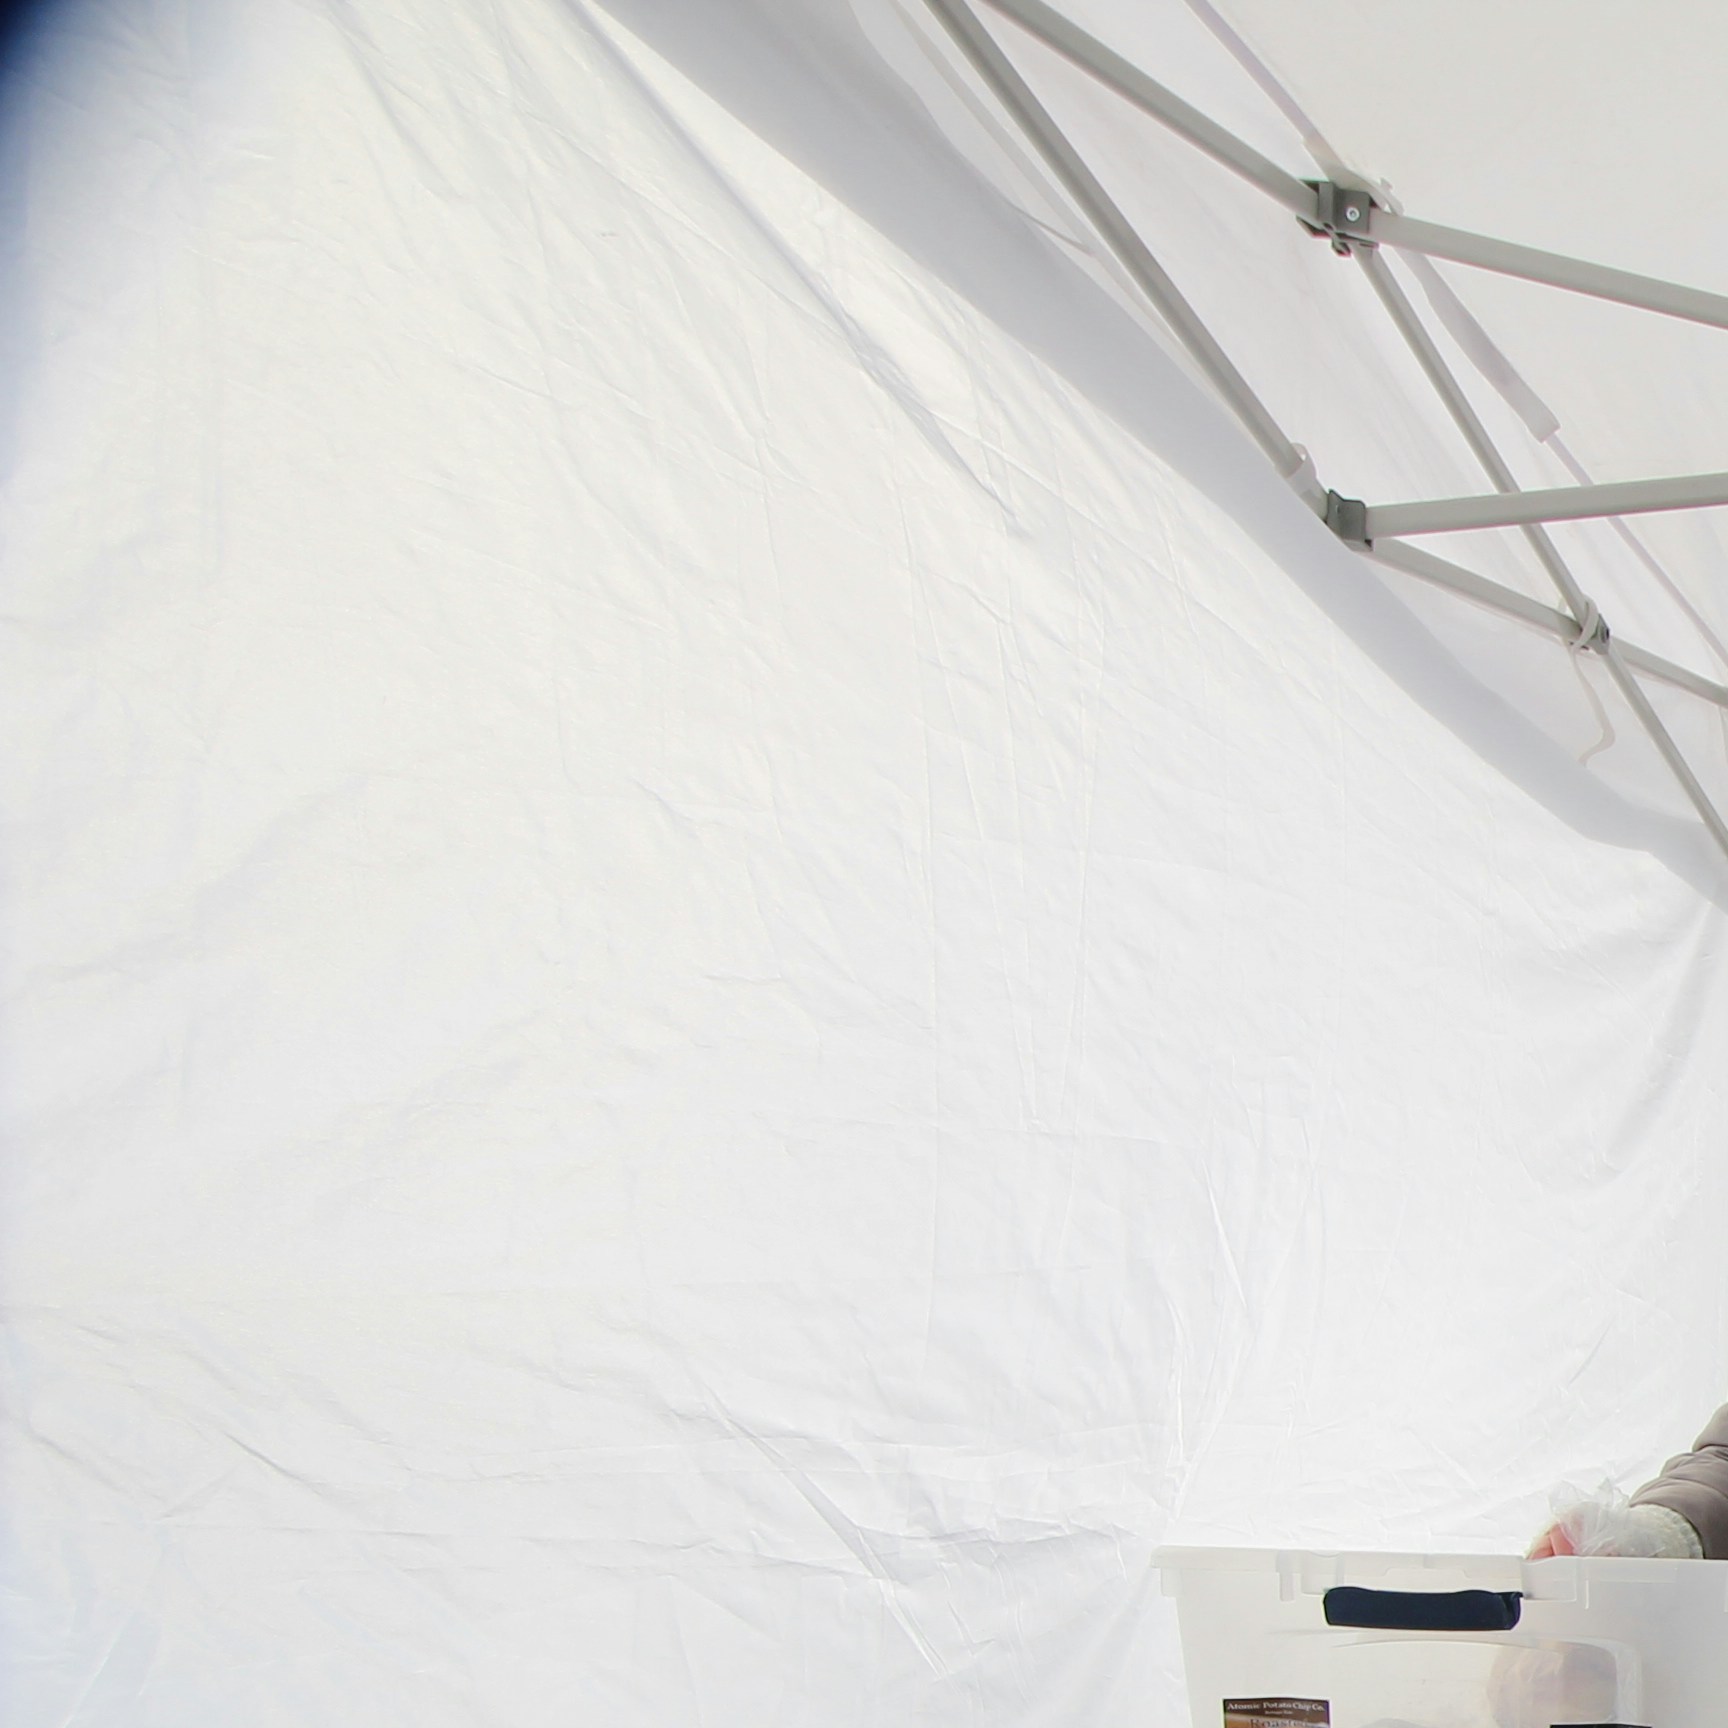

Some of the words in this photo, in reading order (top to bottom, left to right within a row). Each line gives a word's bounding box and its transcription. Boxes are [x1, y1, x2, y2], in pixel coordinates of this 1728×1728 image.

[1227, 1702, 1260, 1711] Atomic
[1263, 1702, 1292, 1710] Potato
[1293, 1702, 1312, 1712] Chip
